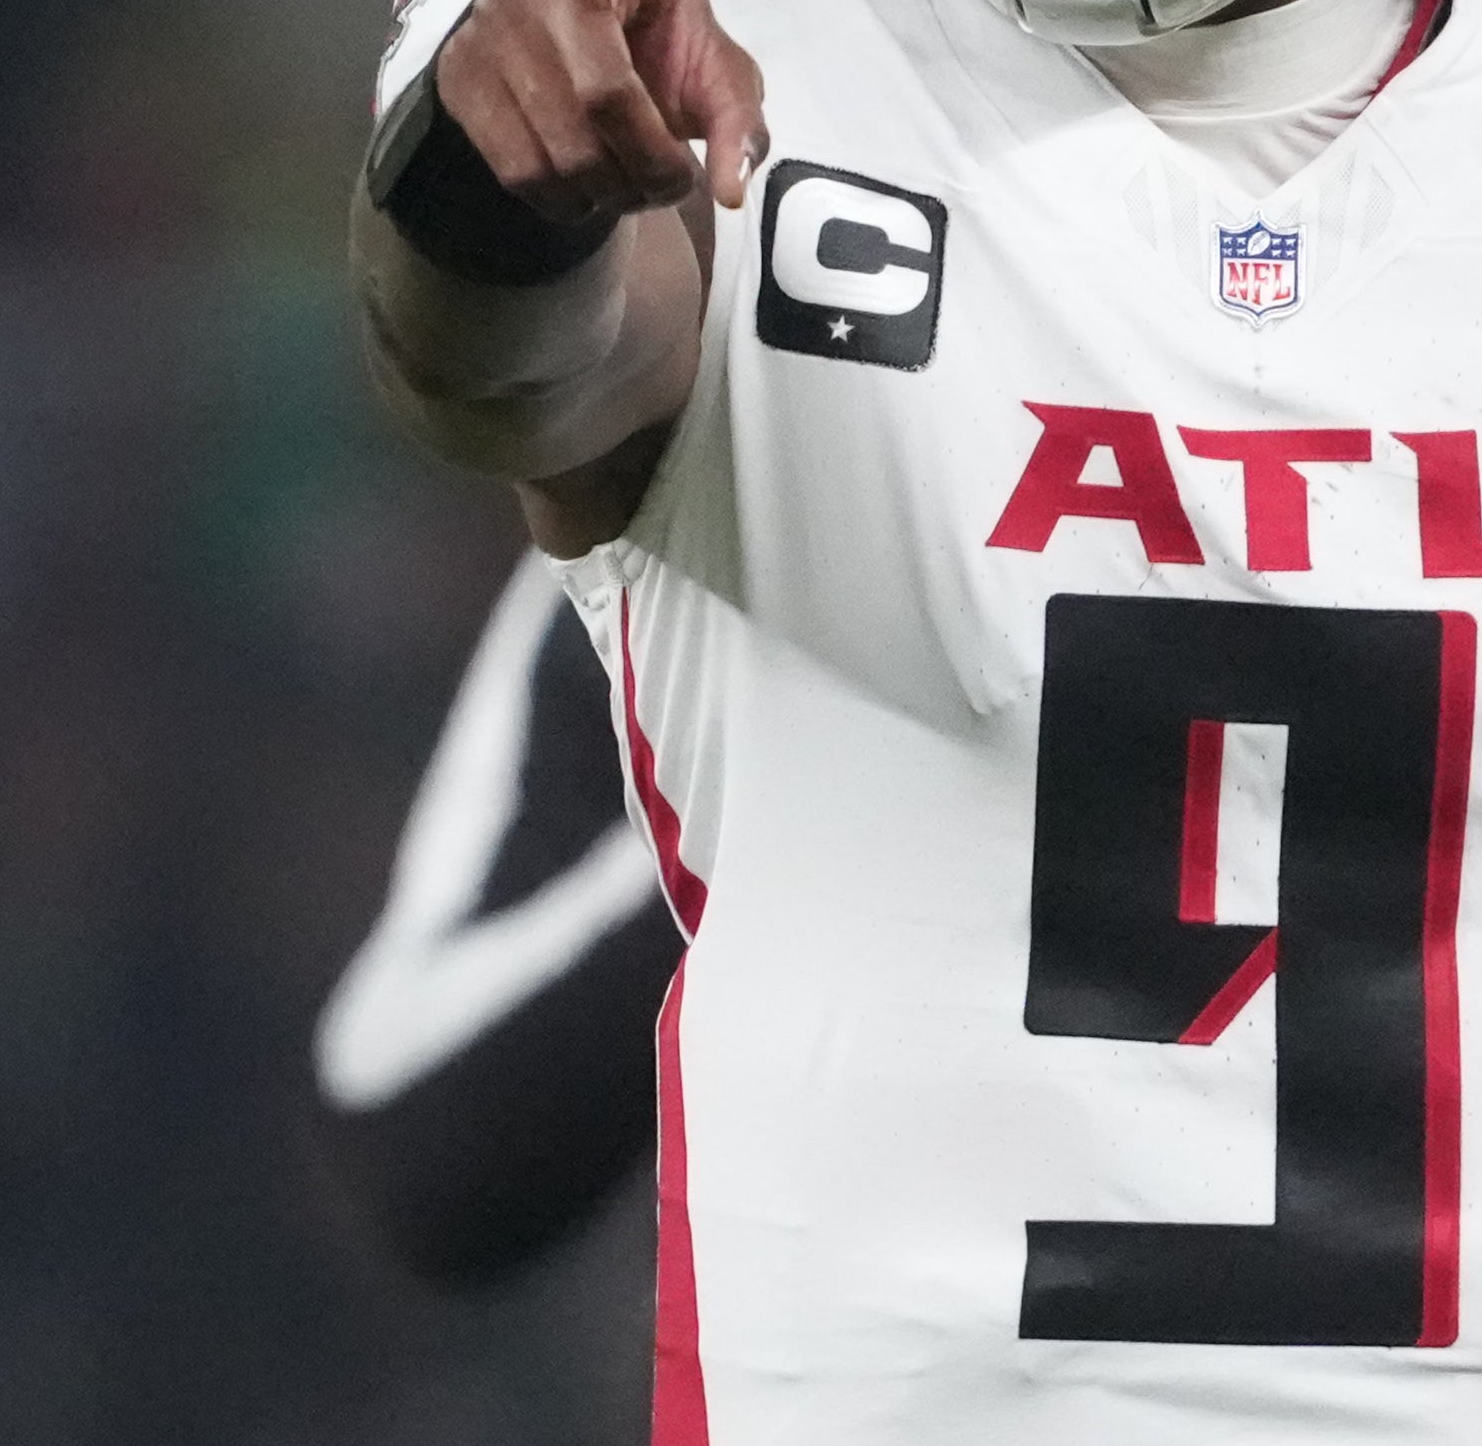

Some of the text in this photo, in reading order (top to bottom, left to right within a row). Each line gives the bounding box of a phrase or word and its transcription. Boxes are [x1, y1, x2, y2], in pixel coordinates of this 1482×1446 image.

[771, 176, 933, 316] C
[1227, 261, 1291, 306] NFL
[1017, 591, 1477, 1348] 9
